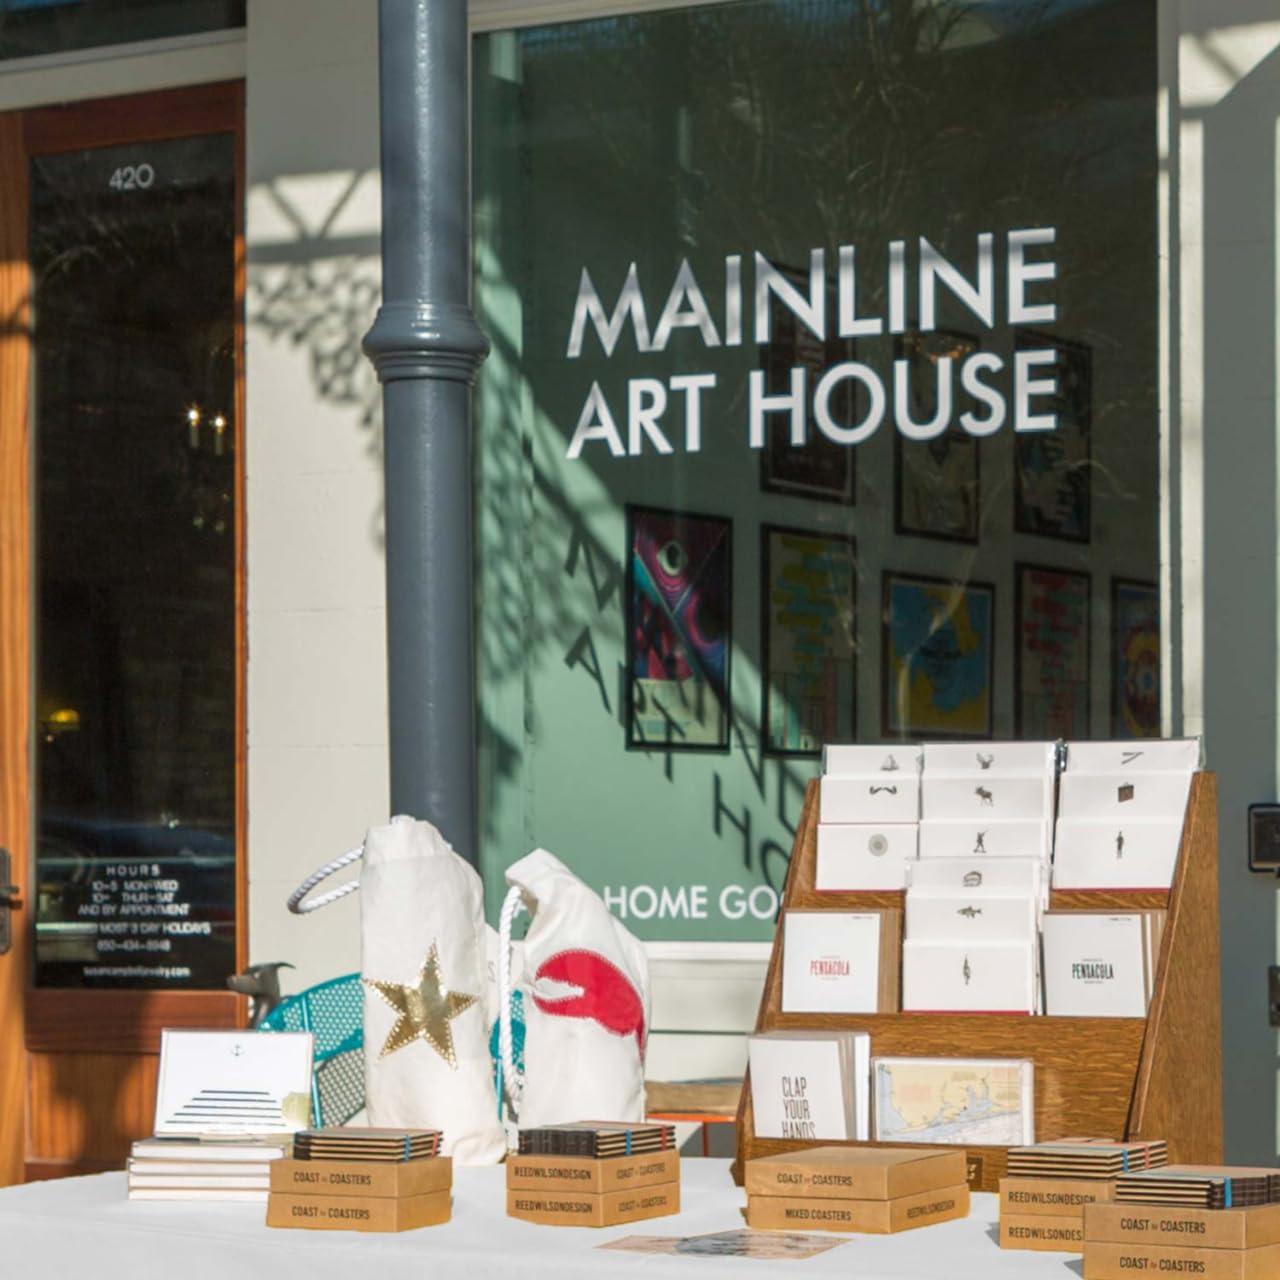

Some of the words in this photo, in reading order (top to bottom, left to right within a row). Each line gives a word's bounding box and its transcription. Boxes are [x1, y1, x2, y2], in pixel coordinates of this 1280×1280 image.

[109, 164, 154, 190] 420
[567, 227, 1056, 358] MAINLINE
[566, 373, 717, 459] ART
[749, 349, 1056, 448] HOUSE
[106, 864, 161, 876] HOURS
[78, 904, 99, 916] AND
[102, 904, 117, 916] BY
[119, 903, 191, 916] APPOINTMENT
[603, 885, 708, 918] HOME
[719, 885, 785, 919] GO
[162, 922, 212, 936] HOLIDAYS
[810, 960, 850, 977] PENSACOLA
[1072, 963, 1115, 980] PENSACOLA
[781, 1076, 807, 1097] CLAP
[783, 1098, 811, 1120] YOUR
[781, 1121, 817, 1139] HANDS
[293, 1171, 321, 1183] COAST
[329, 1173, 372, 1186] COASTERS
[514, 1165, 592, 1181] REEDWILSONDESIGN
[776, 1172, 803, 1185] COAST
[812, 1174, 854, 1187] COASTERS
[1008, 1190, 1097, 1206] REEDWILSONDESIGN
[291, 1205, 319, 1218] COAST
[328, 1207, 371, 1221] COASTERS
[515, 1199, 593, 1214] REEDWILSONDESIGN
[785, 1208, 810, 1219] MIXED
[811, 1209, 852, 1222] COASTERS
[1120, 1217, 1149, 1231] COAST
[1159, 1219, 1206, 1234] COASTERS
[1008, 1226, 1083, 1242] REEDWILSONDES
[1119, 1256, 1149, 1270] COAST
[1159, 1258, 1206, 1274] COASTERS
